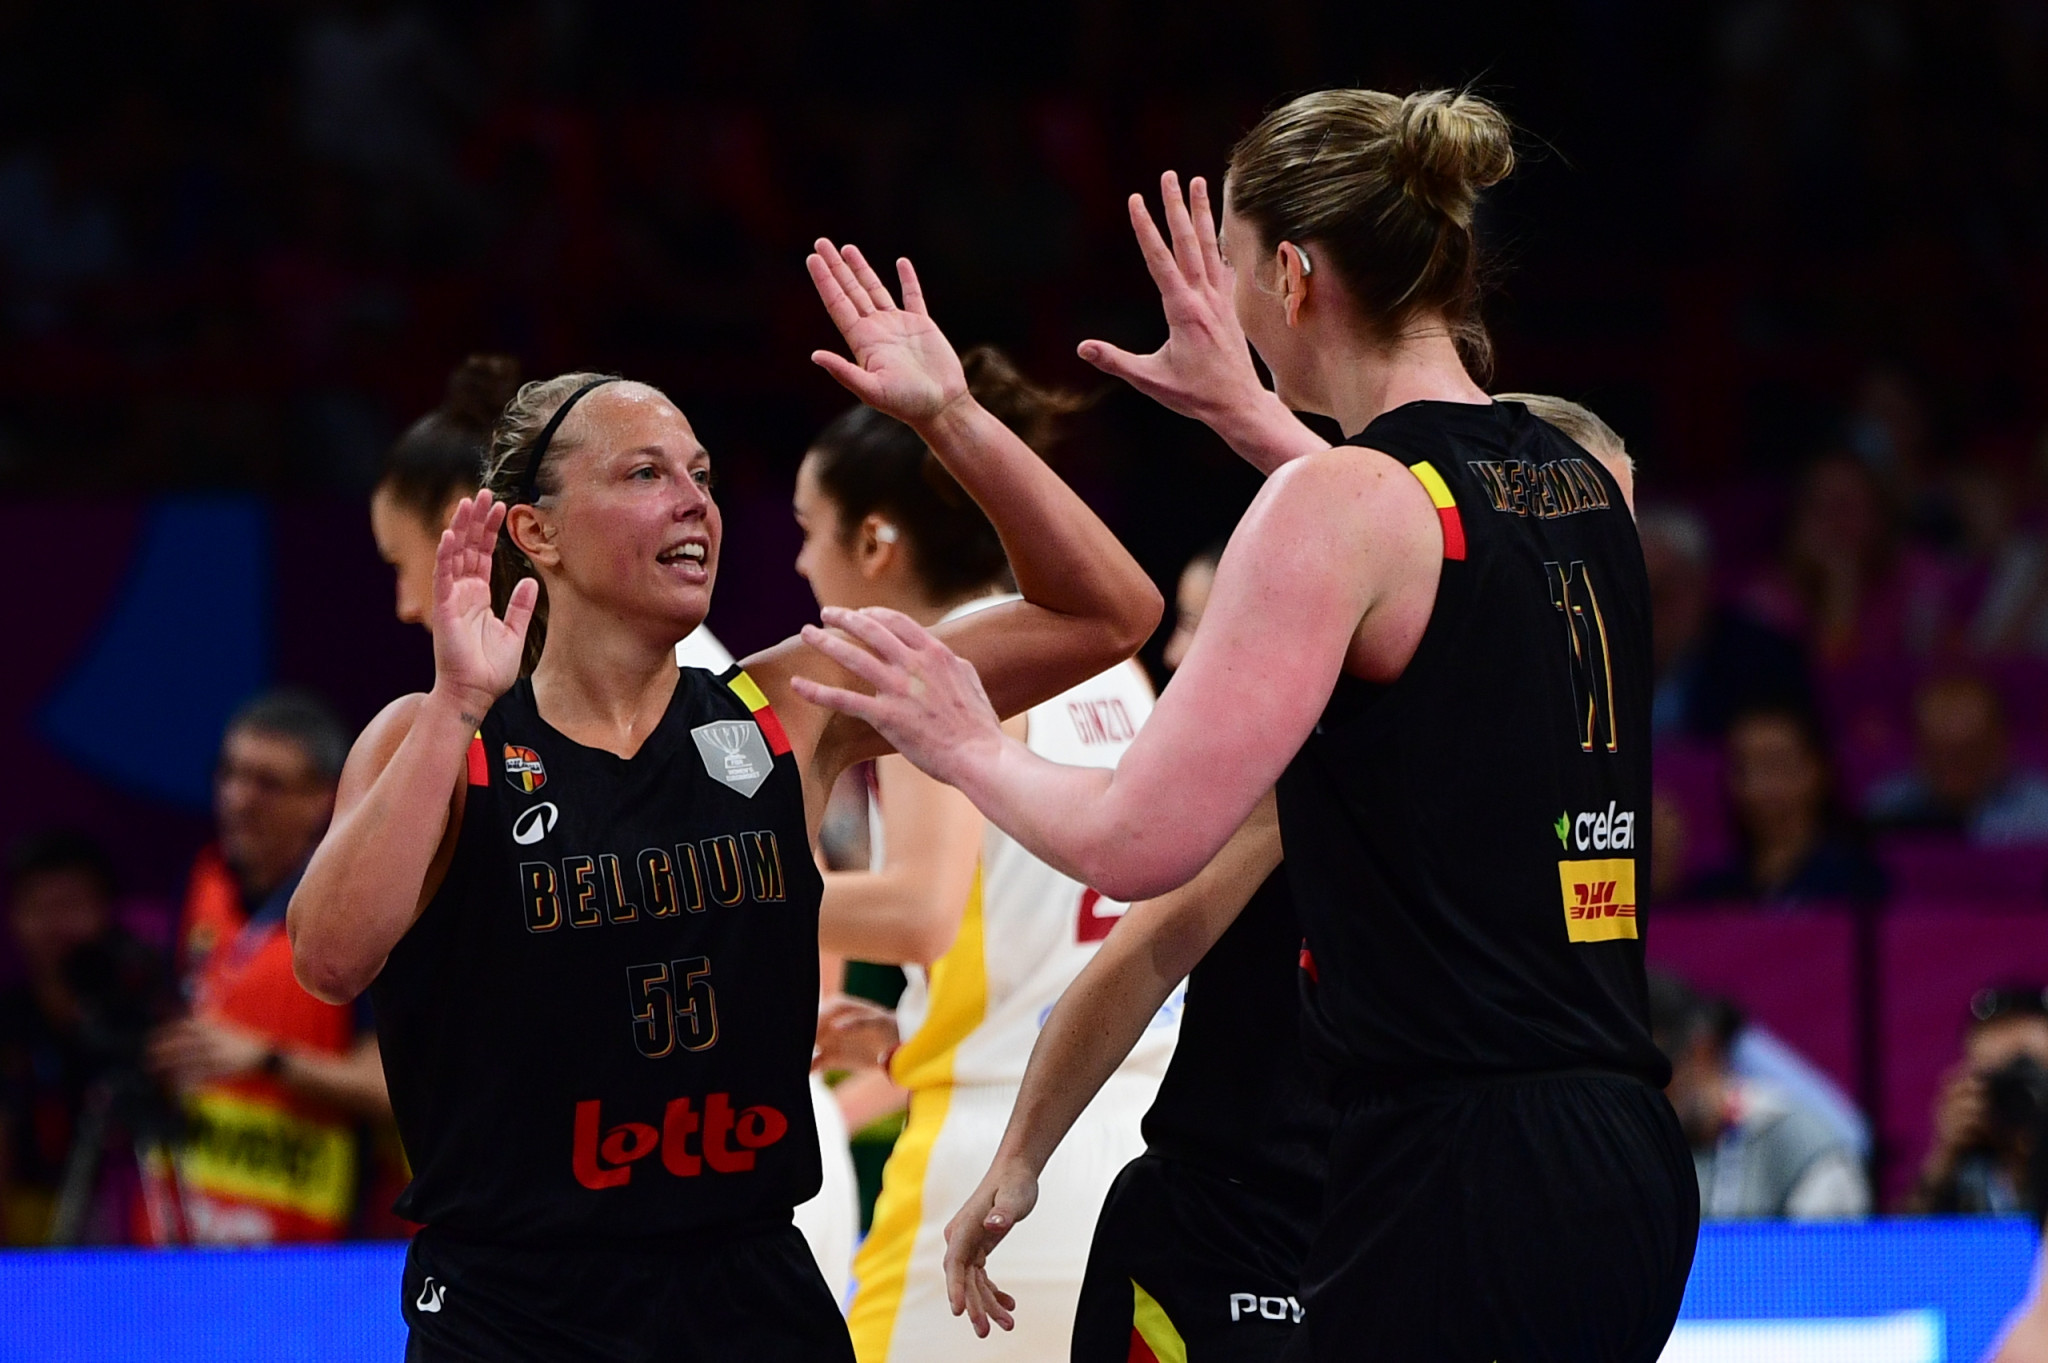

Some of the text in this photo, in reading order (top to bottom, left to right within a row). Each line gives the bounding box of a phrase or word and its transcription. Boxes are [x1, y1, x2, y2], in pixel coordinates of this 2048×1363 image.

[1543, 560, 1617, 752] 11
[1068, 699, 1136, 745] GINZO
[519, 830, 786, 934] BELGIUM
[1571, 880, 1621, 920] DHL
[626, 955, 720, 1059] 55
